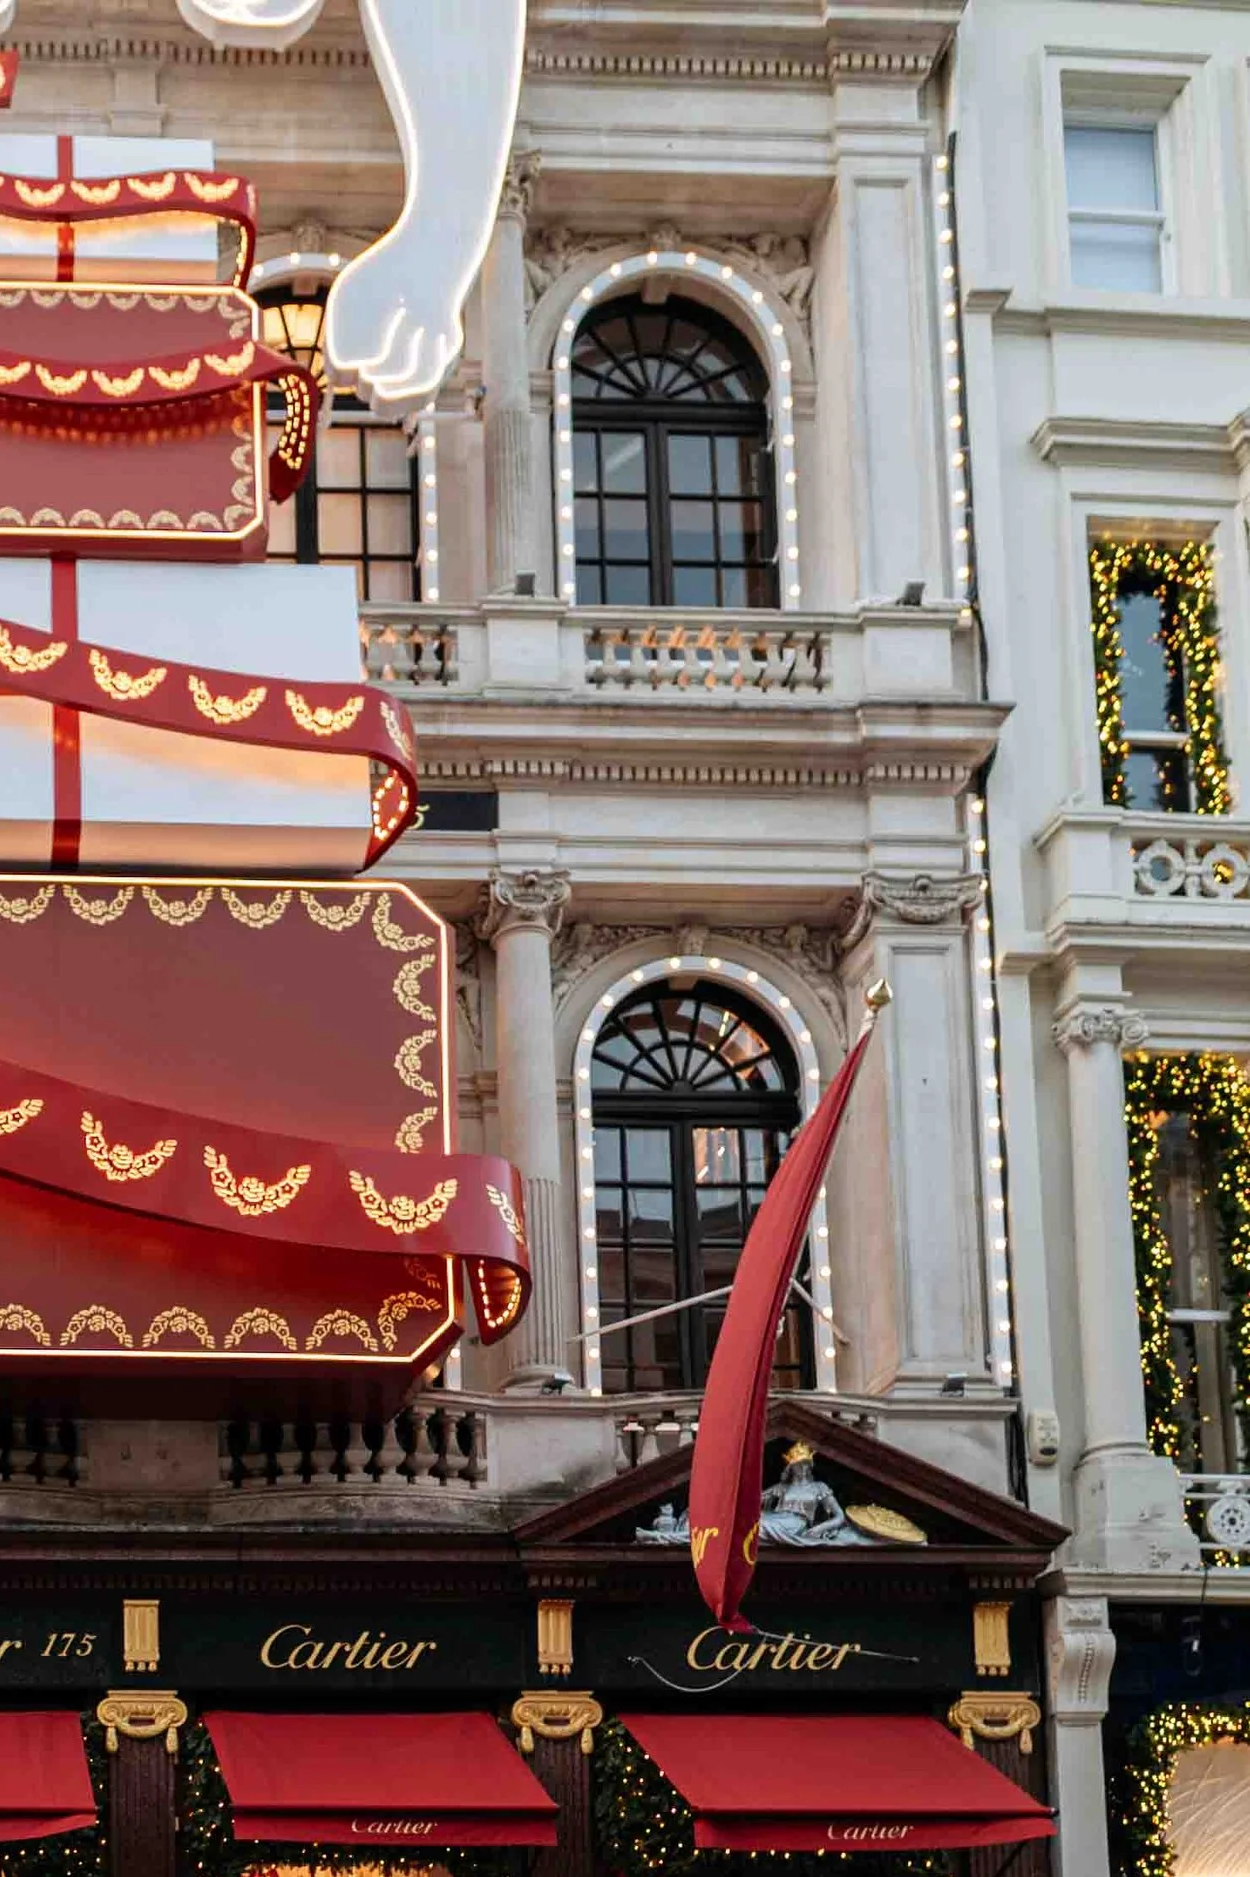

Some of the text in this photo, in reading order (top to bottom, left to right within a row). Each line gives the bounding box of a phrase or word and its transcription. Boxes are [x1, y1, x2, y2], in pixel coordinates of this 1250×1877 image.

[40, 1632, 97, 1657] 175
[261, 1624, 437, 1670] Cartier
[686, 1624, 862, 1671] Cartier
